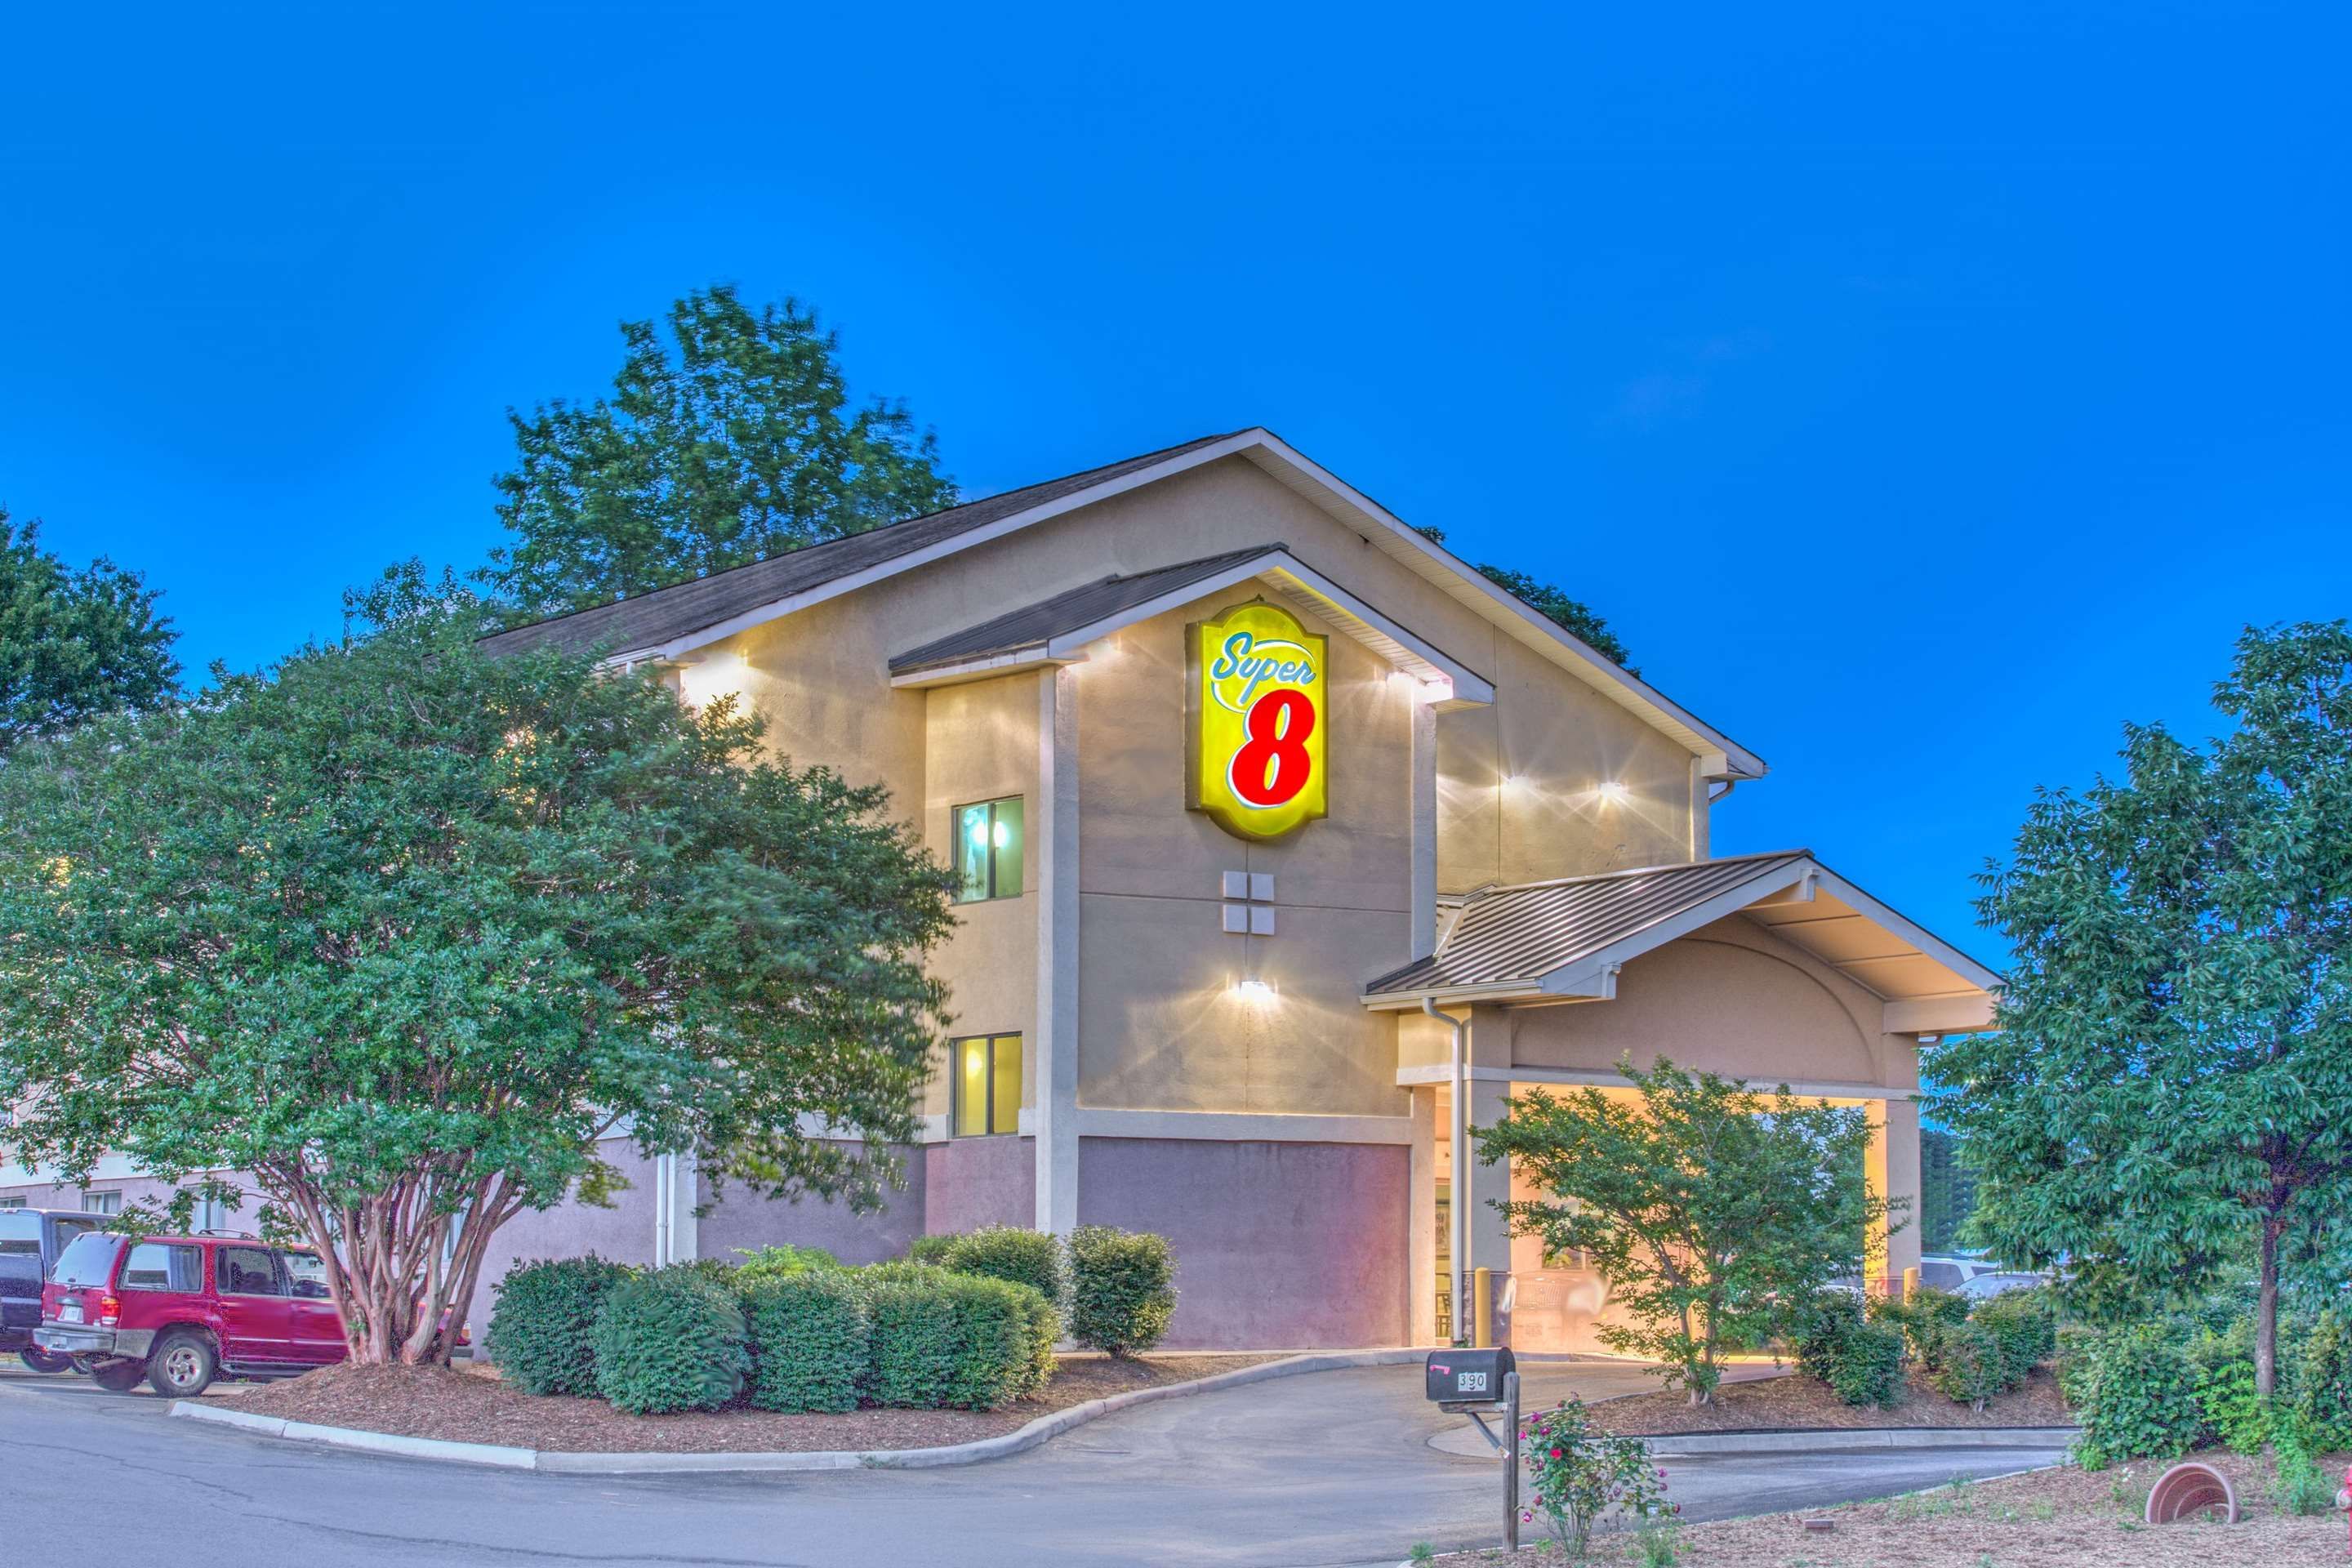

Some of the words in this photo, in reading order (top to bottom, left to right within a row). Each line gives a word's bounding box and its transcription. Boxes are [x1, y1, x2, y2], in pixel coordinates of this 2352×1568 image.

[1212, 631, 1316, 706] Super
[1227, 688, 1316, 808] 8
[1459, 1374, 1484, 1387] 390
